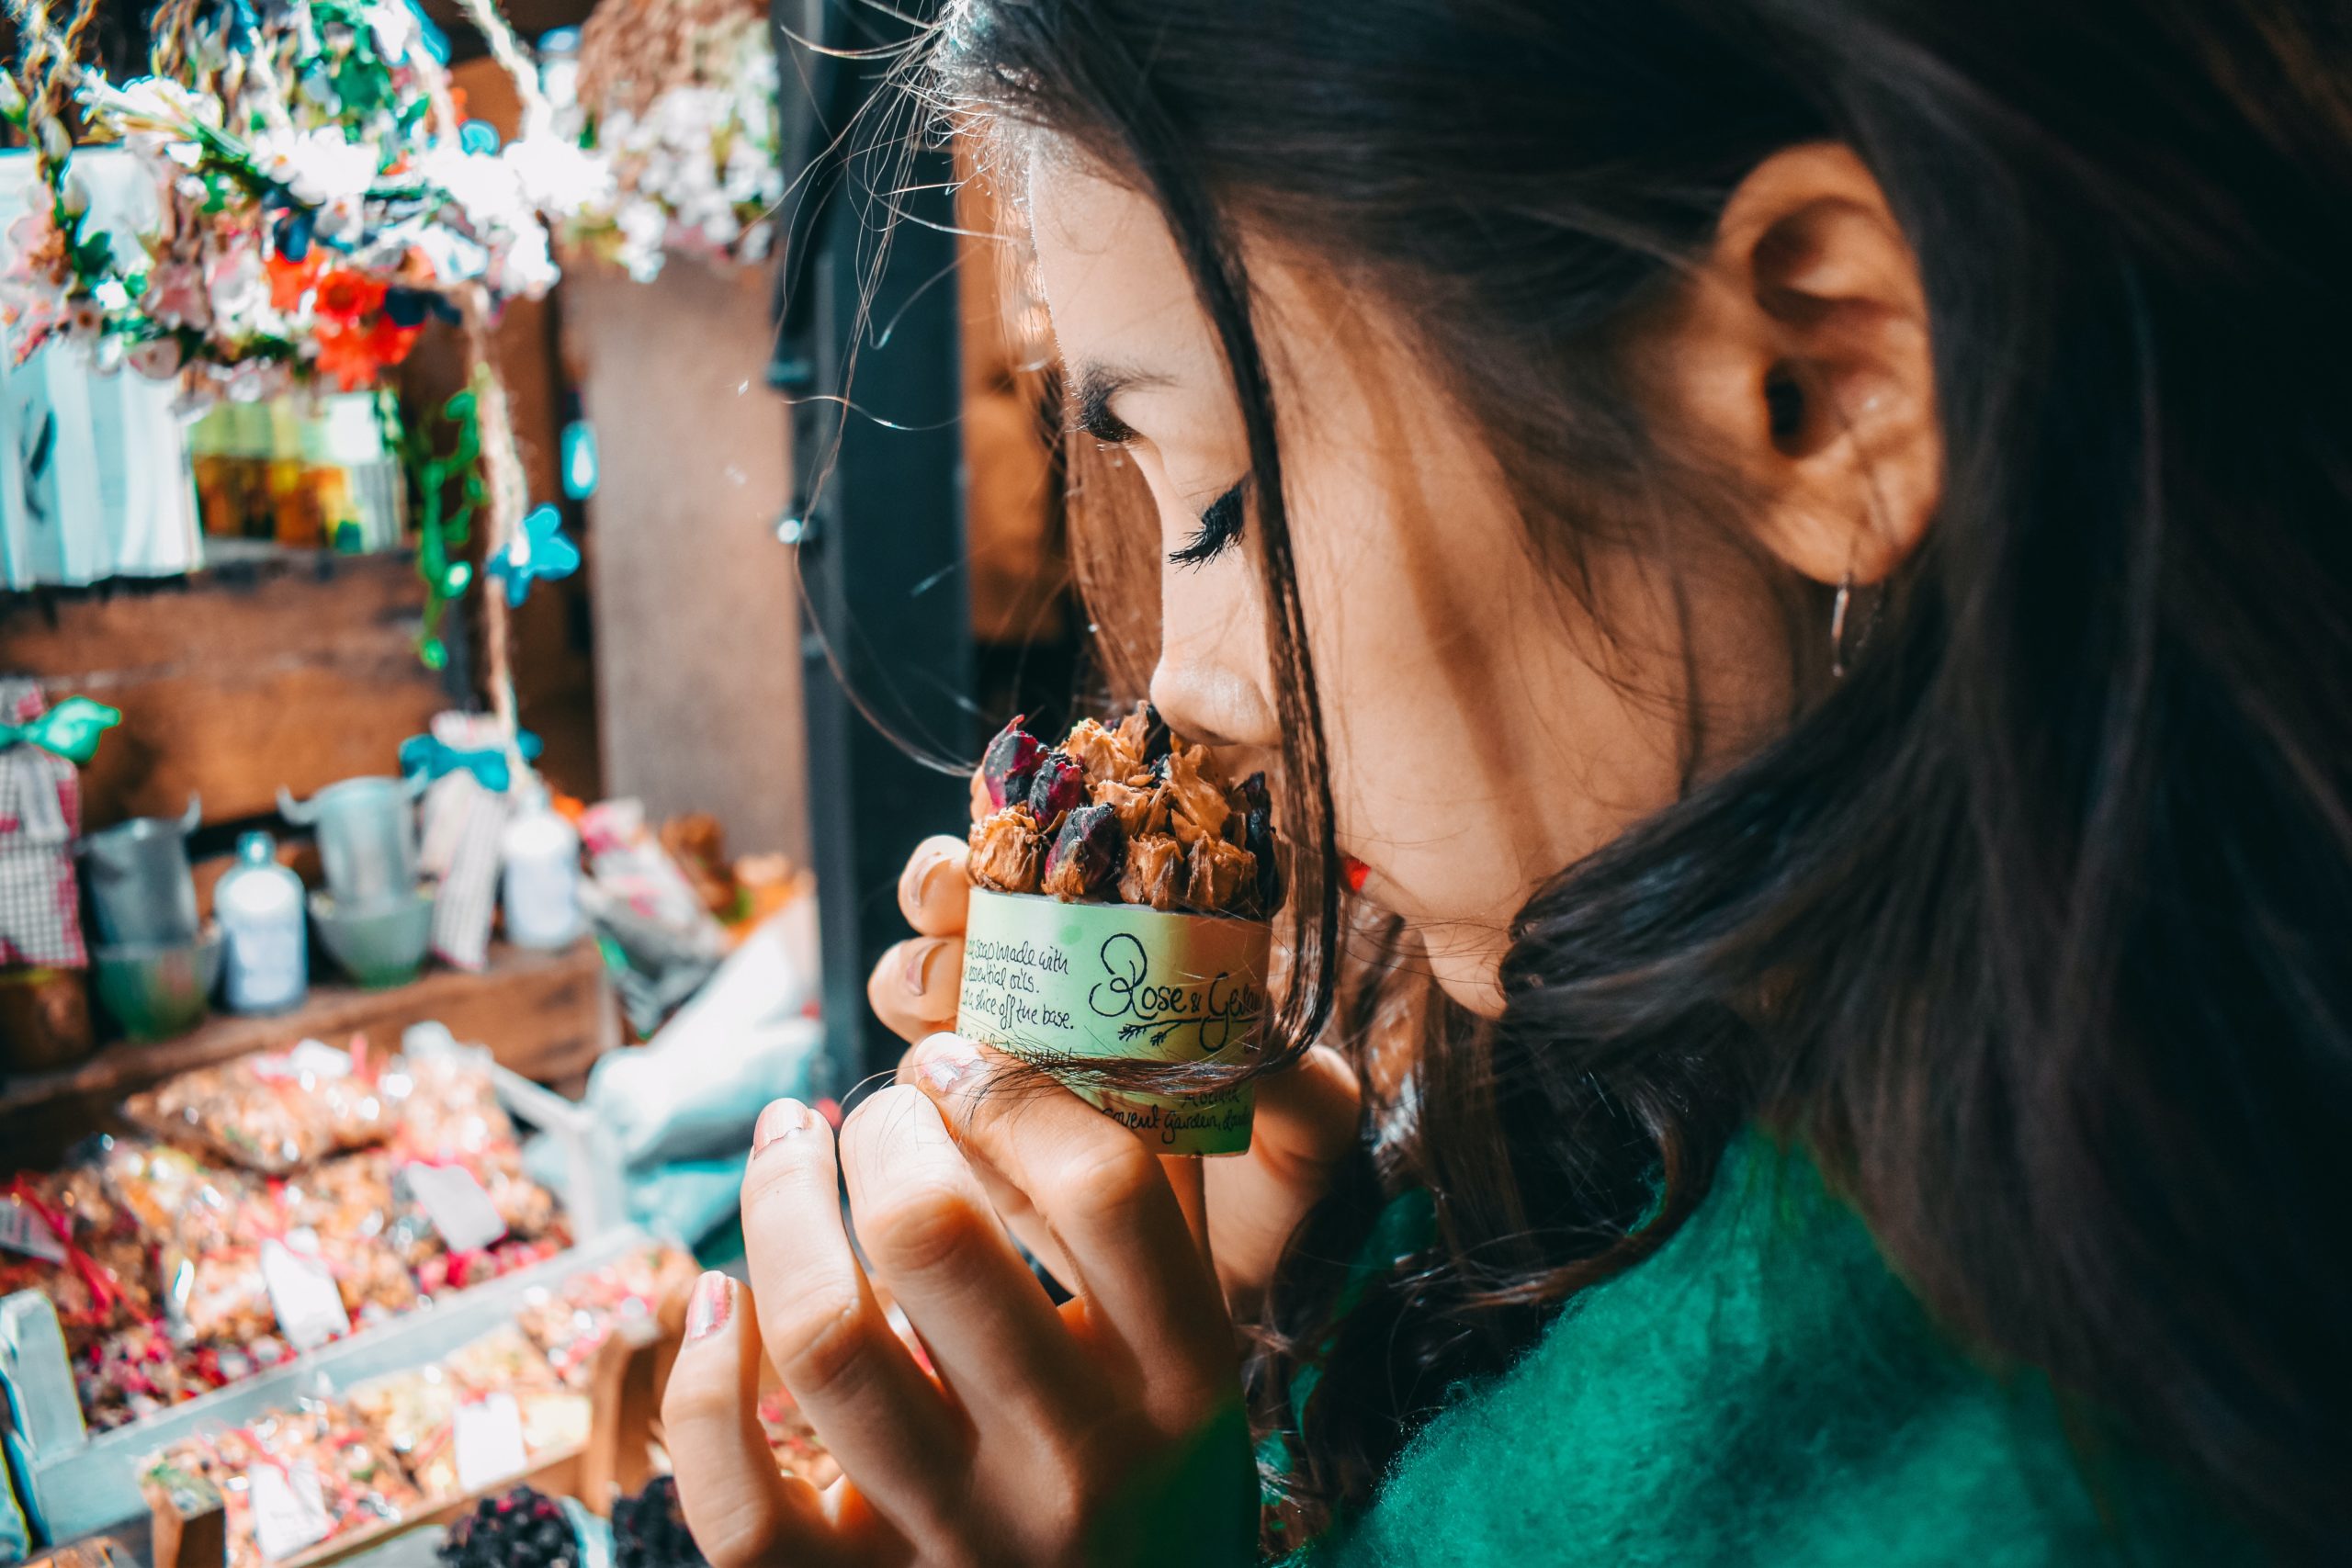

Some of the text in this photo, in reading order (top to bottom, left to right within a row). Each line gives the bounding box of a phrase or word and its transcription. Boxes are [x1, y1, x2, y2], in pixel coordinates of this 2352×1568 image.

[996, 941, 1036, 966] made
[1038, 945, 1069, 975] with
[1089, 933, 1188, 1021] Rose
[1191, 992, 1202, 1013] &
[968, 964, 1007, 990] essential
[1010, 968, 1040, 993] oils.
[976, 989, 996, 1015] slice
[999, 993, 1015, 1031] off
[1016, 998, 1038, 1024] the
[1043, 1003, 1074, 1030] base.
